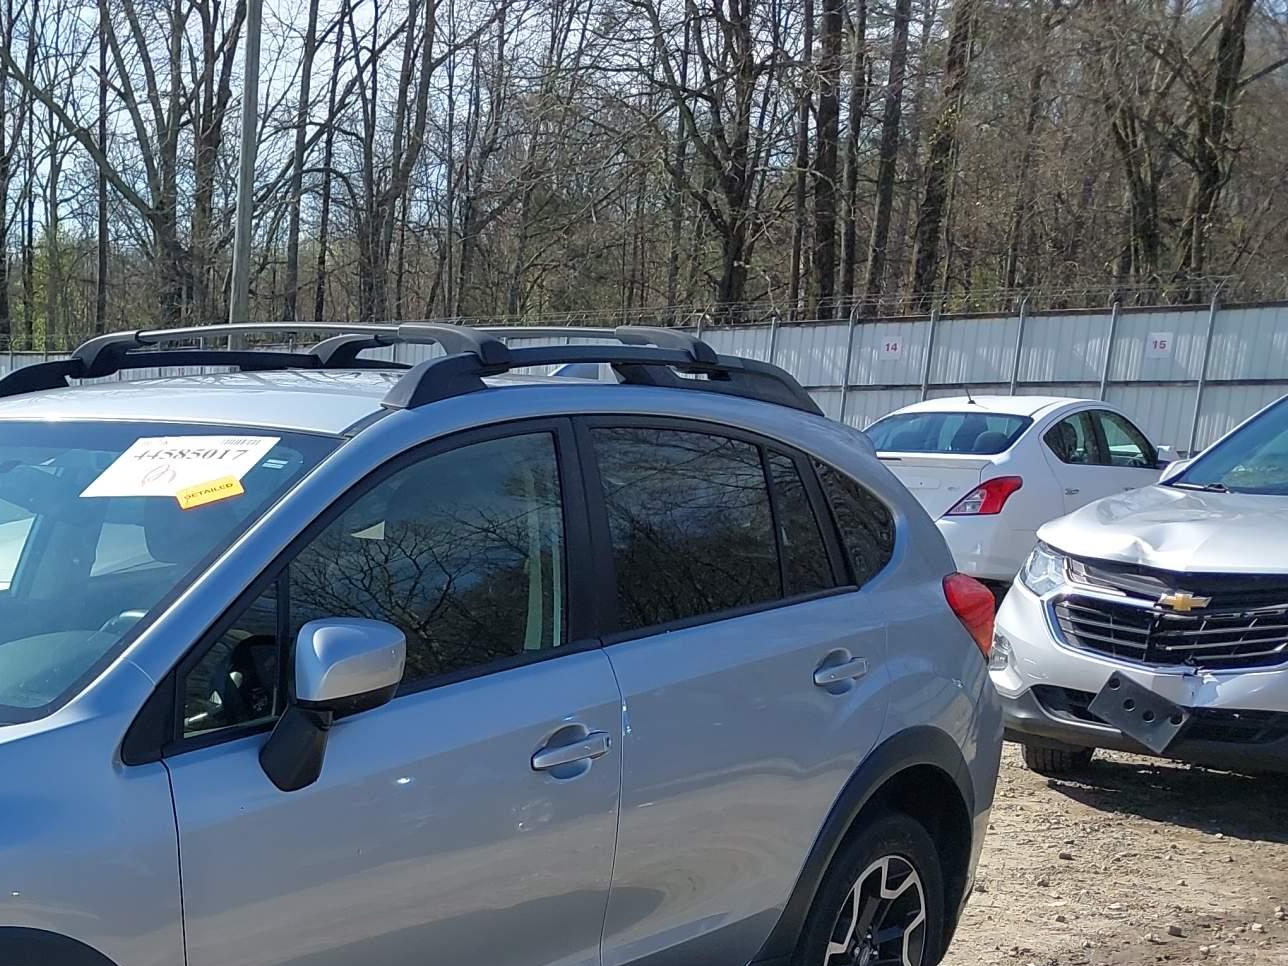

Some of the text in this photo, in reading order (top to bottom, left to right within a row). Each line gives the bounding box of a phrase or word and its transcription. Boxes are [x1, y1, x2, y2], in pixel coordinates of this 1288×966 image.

[884, 342, 899, 353] 14
[1151, 340, 1167, 351] 15
[134, 448, 249, 461] 44585017
